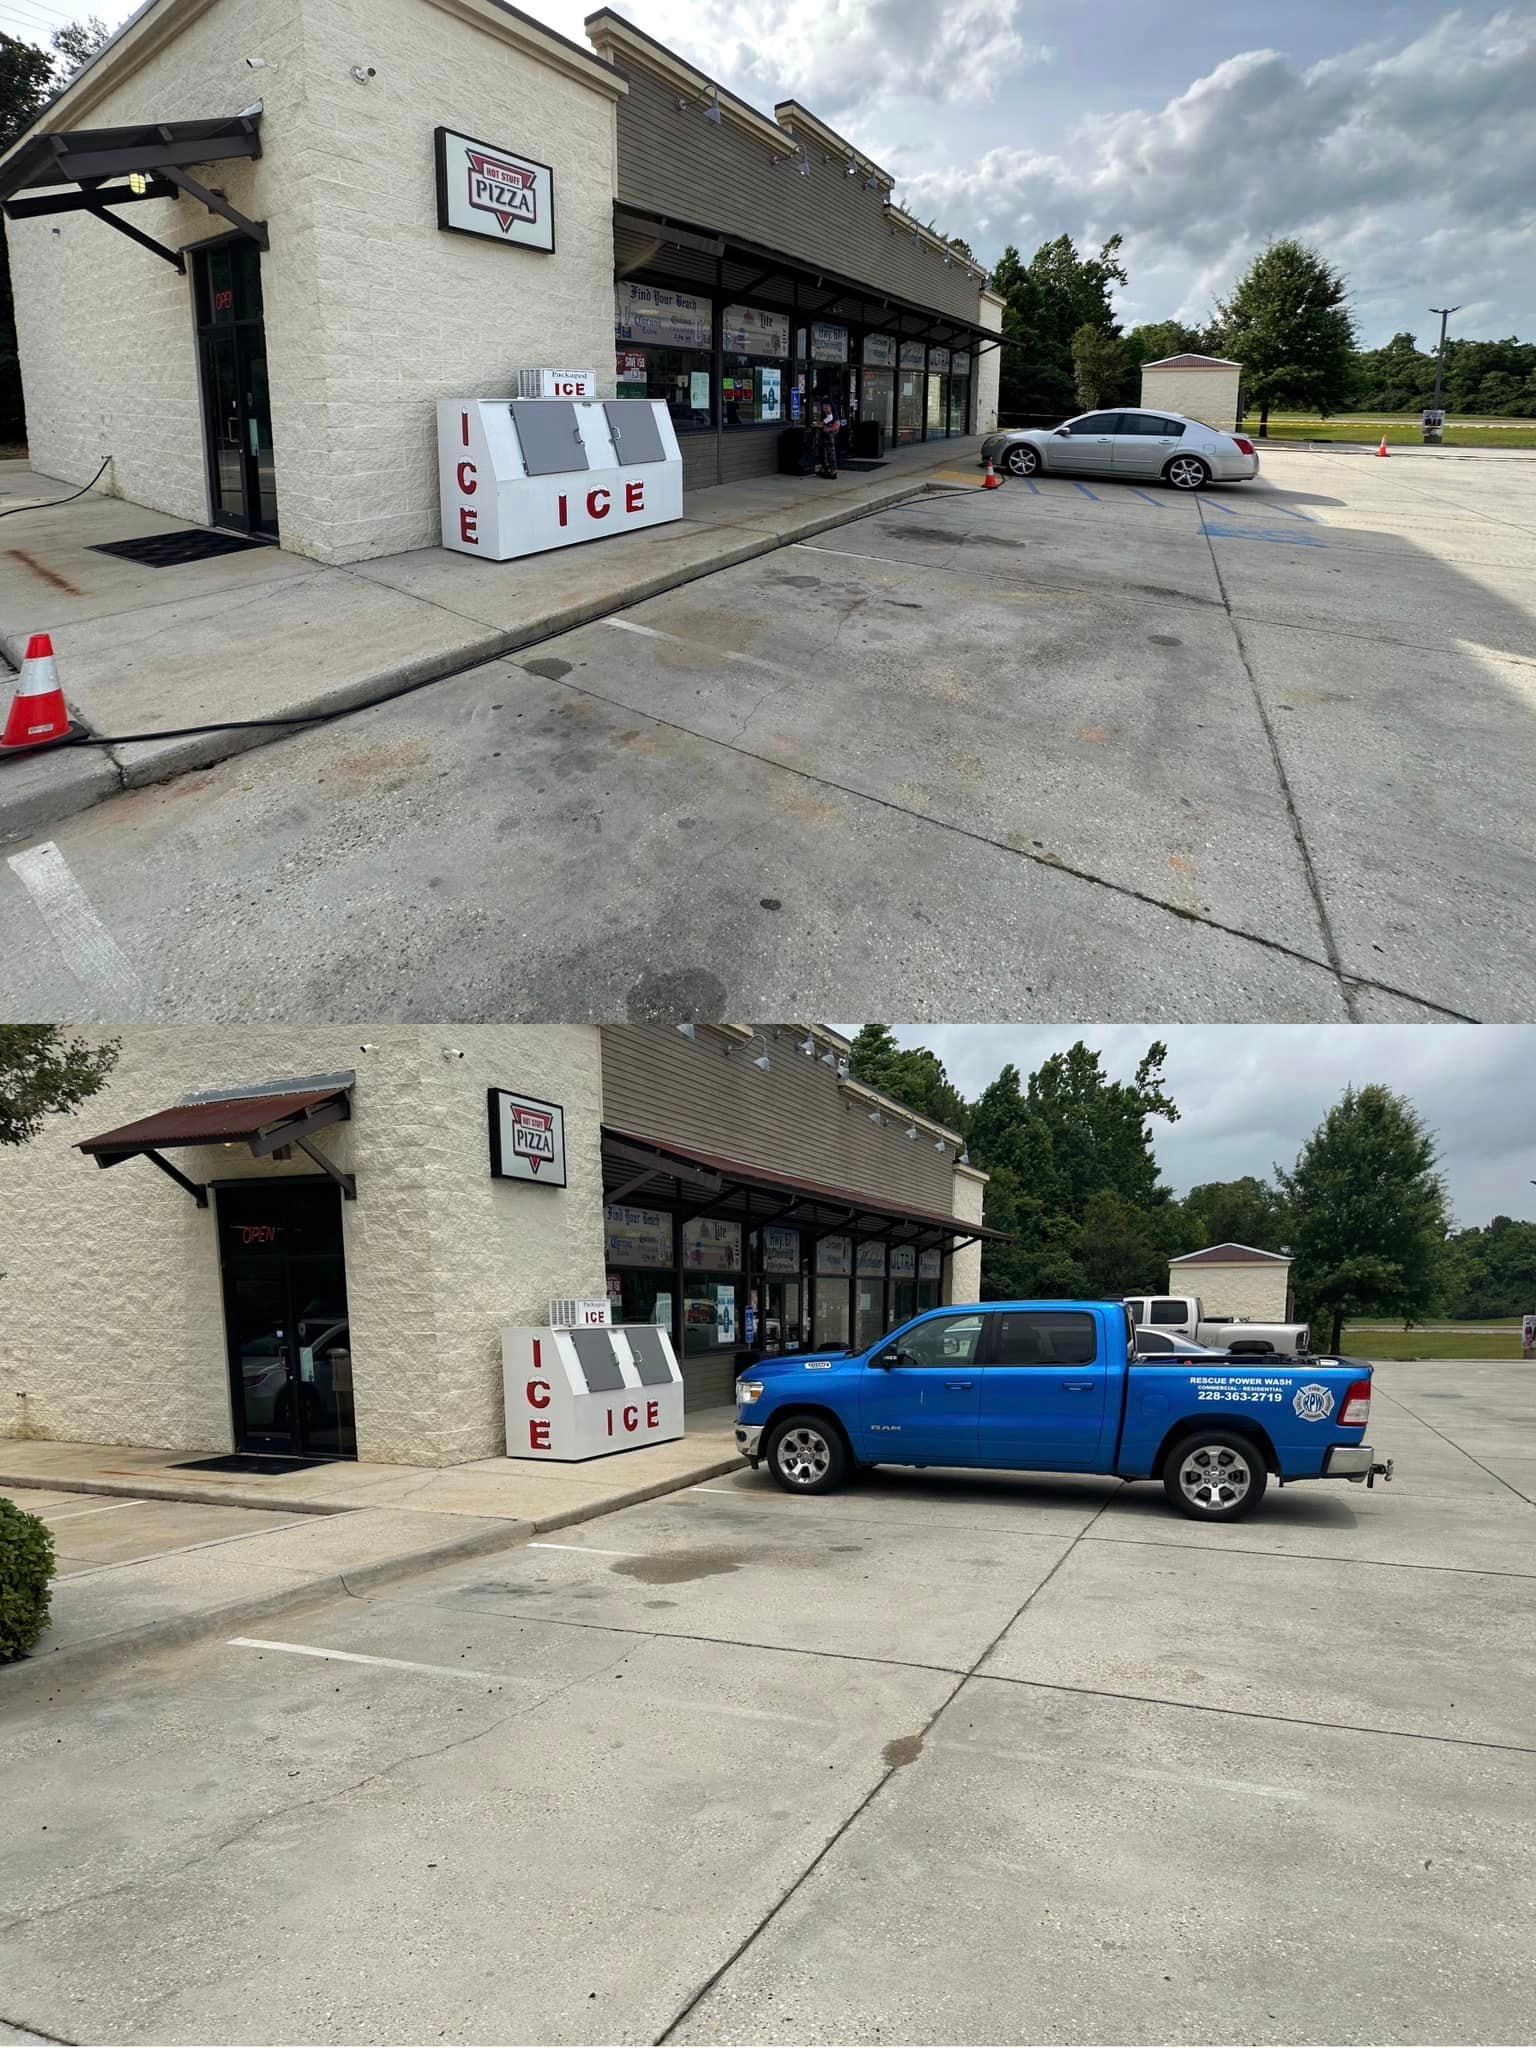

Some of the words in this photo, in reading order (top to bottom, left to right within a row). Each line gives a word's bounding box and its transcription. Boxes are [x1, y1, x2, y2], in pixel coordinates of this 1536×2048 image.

[486, 167, 500, 178] HOT
[501, 172, 521, 185] STUFF
[476, 179, 530, 213] PIZZA
[630, 284, 651, 302] Find
[653, 289, 673, 306] Your
[675, 294, 697, 312] Beach
[760, 313, 774, 329] Lite
[552, 371, 588, 379] Packaged
[554, 382, 586, 396] ICE
[456, 407, 479, 545] ICE
[557, 479, 646, 528] ICE
[517, 1129, 551, 1153] PIZZA
[242, 1225, 275, 1244] OPEN
[714, 1223, 727, 1241] Lite
[585, 1311, 605, 1324] ICE
[1190, 1377, 1228, 1385] RESCUE
[1264, 1378, 1293, 1386] WASH
[526, 1335, 552, 1450] ICE
[1197, 1391, 1283, 1402] 228-363-2719
[606, 1399, 660, 1437] ICE
